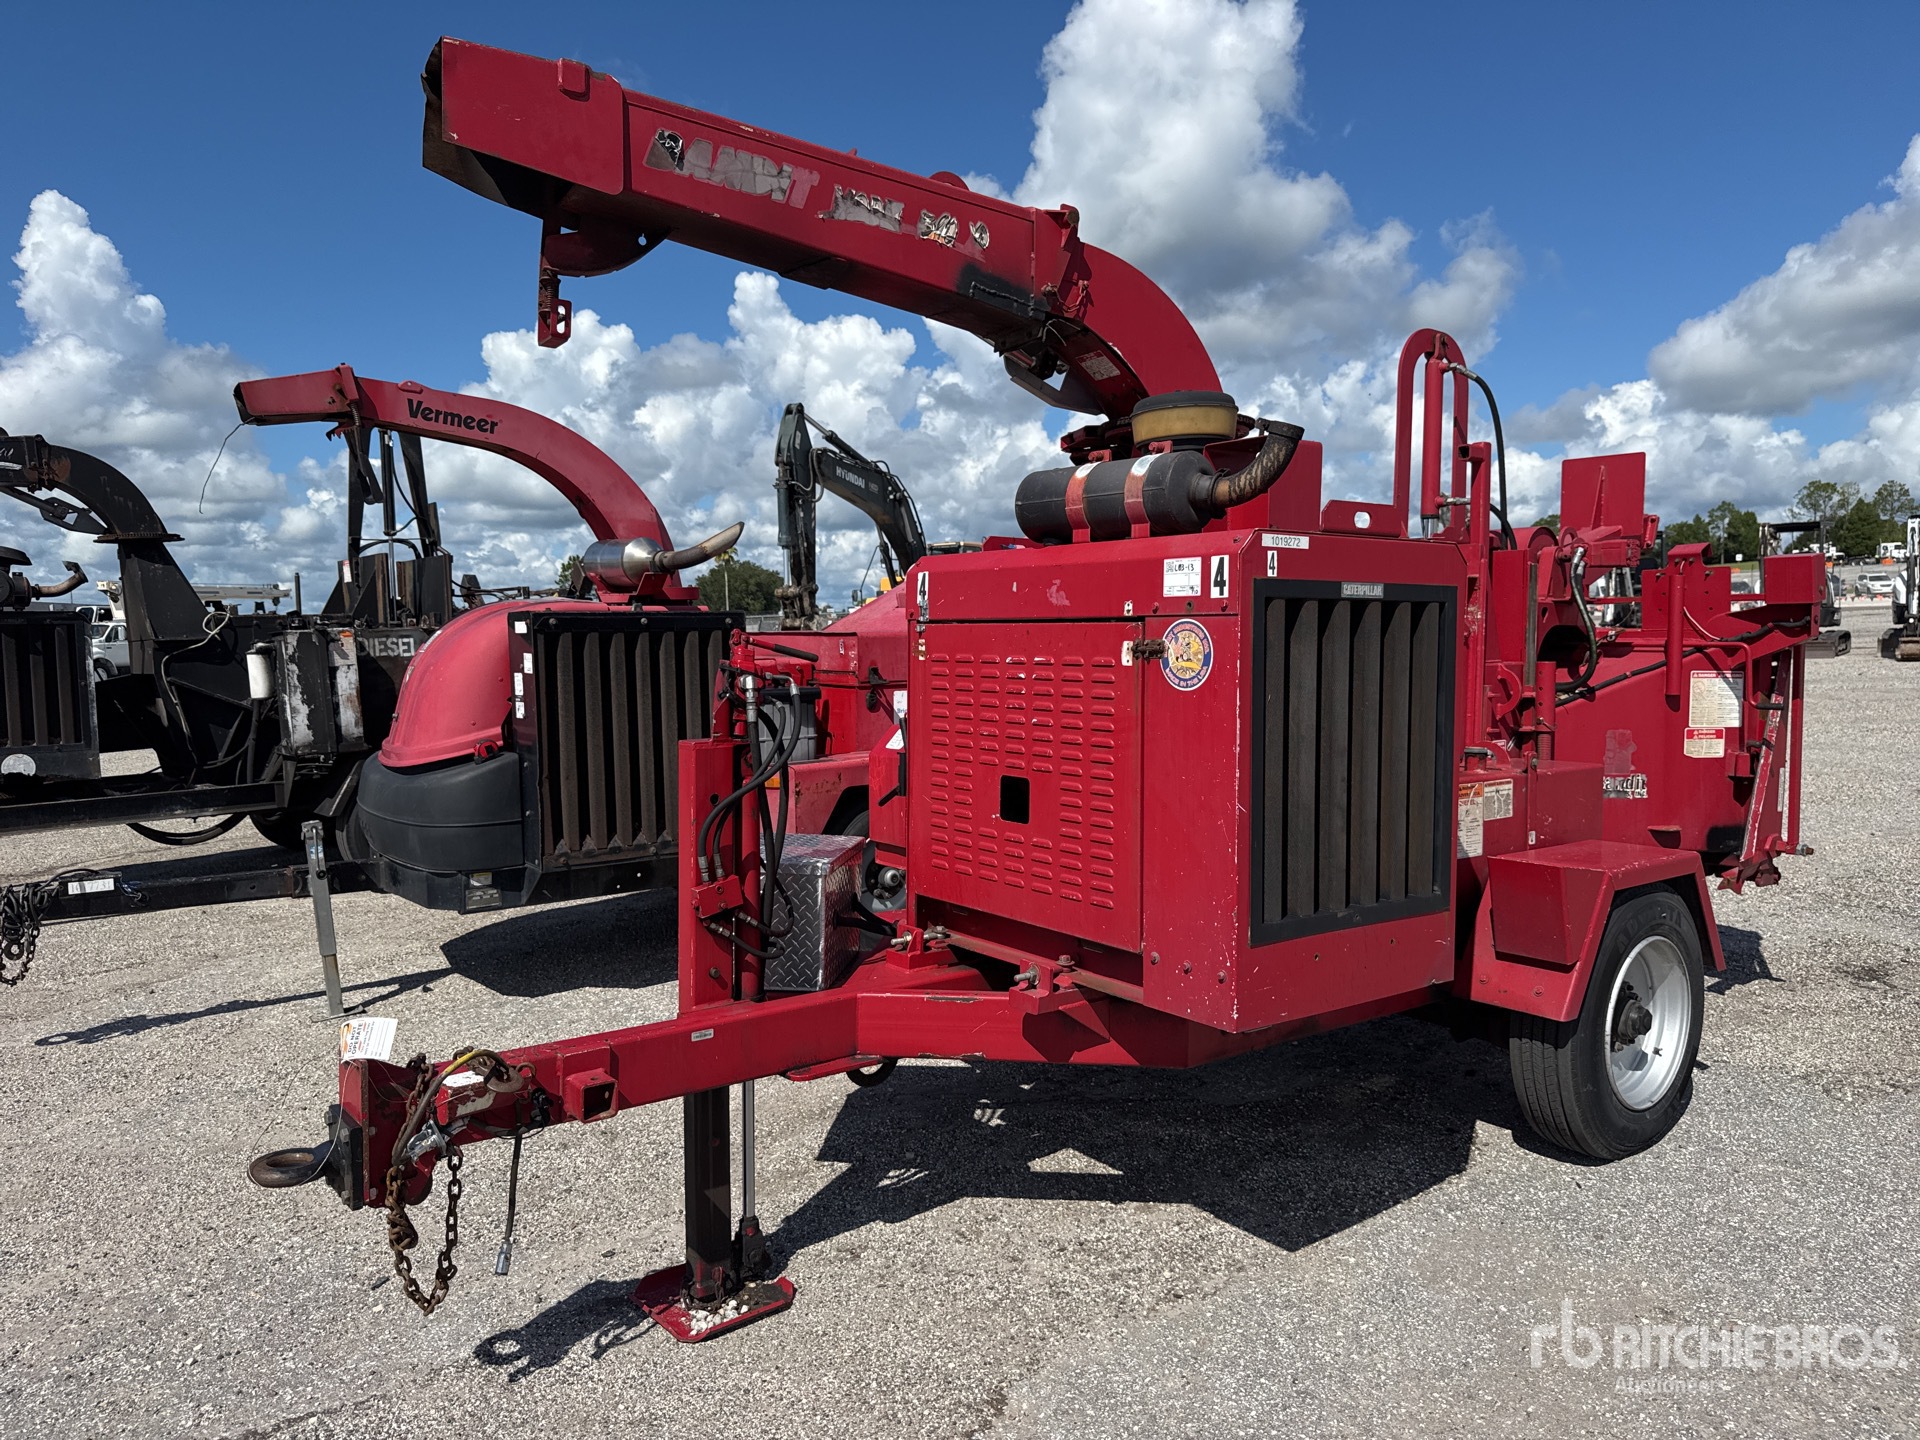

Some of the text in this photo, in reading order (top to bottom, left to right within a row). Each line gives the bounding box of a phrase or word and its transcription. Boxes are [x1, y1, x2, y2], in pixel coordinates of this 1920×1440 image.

[407, 398, 499, 434] Vermeer
[836, 466, 865, 489] HYUNDAI
[1271, 536, 1301, 547] 1019272
[1268, 552, 1276, 575] 4
[1213, 556, 1227, 596] 4
[918, 573, 927, 603] 4
[1343, 584, 1382, 596] CATERPILLAR
